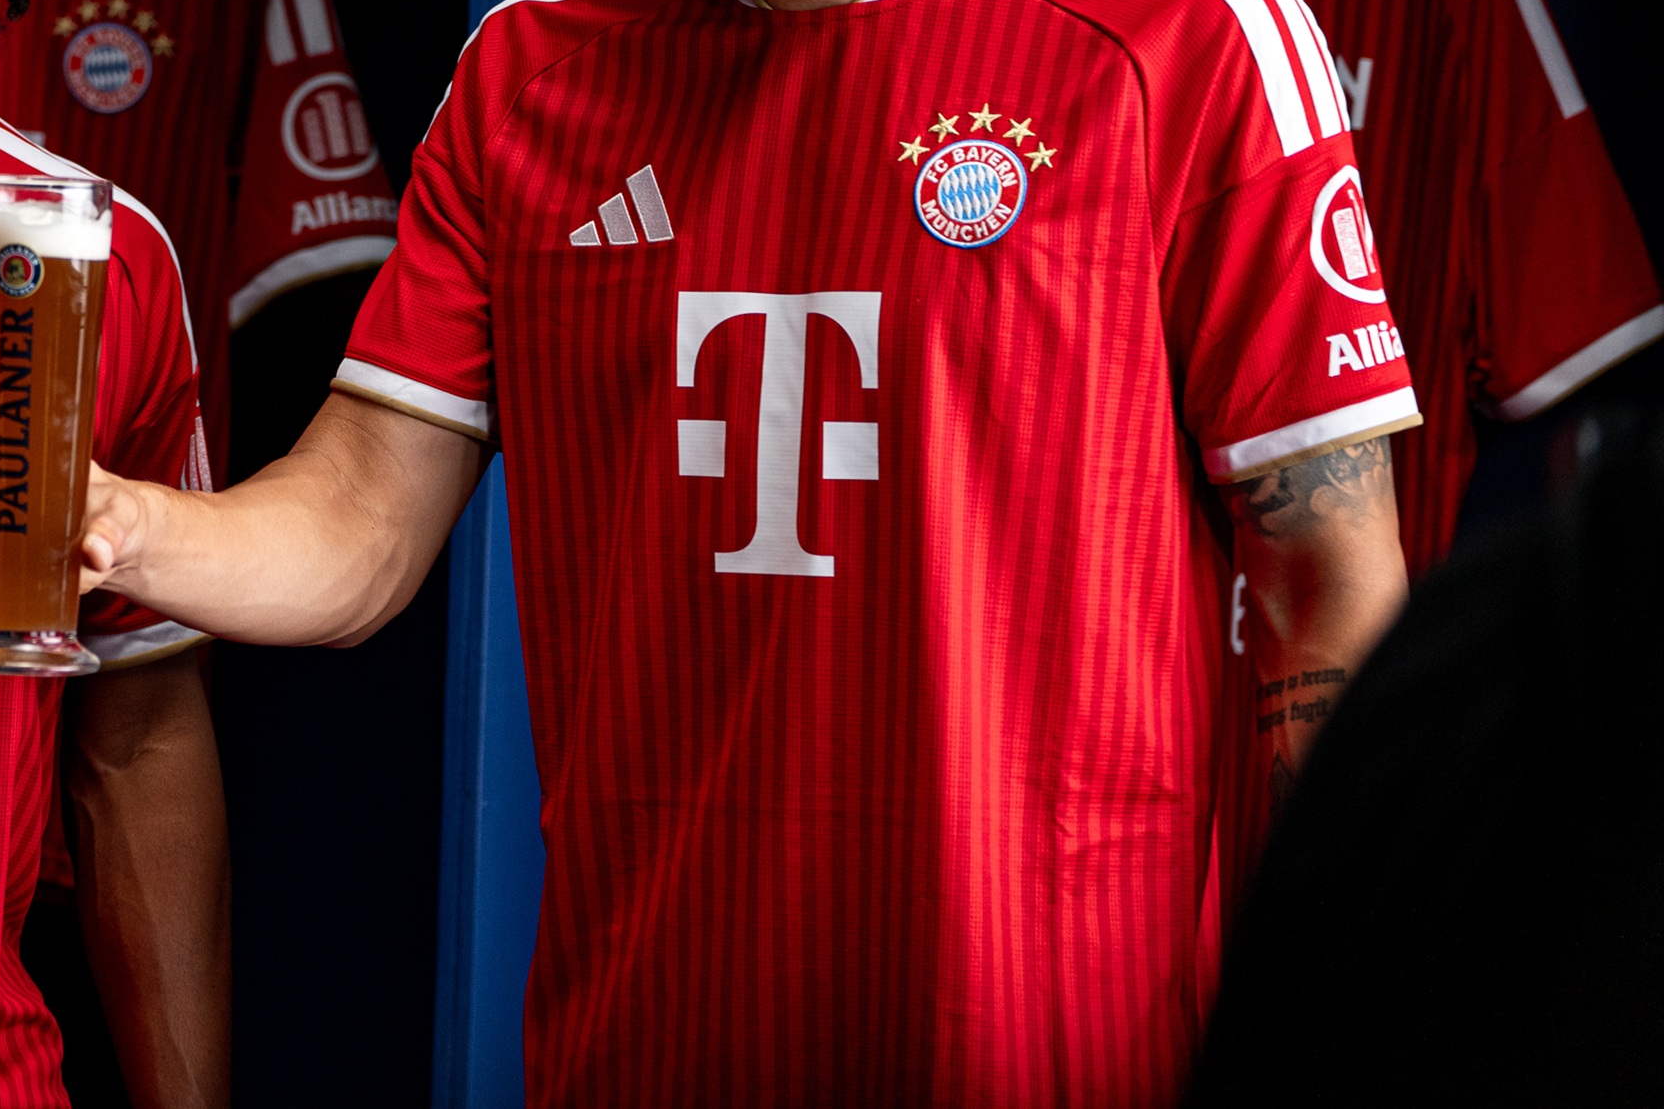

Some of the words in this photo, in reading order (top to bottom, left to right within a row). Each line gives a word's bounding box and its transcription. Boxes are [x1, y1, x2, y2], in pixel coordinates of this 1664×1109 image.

[926, 158, 948, 184] FC
[952, 146, 1018, 188] BAYERN
[1325, 320, 1405, 377] Allia
[677, 290, 882, 577] T
